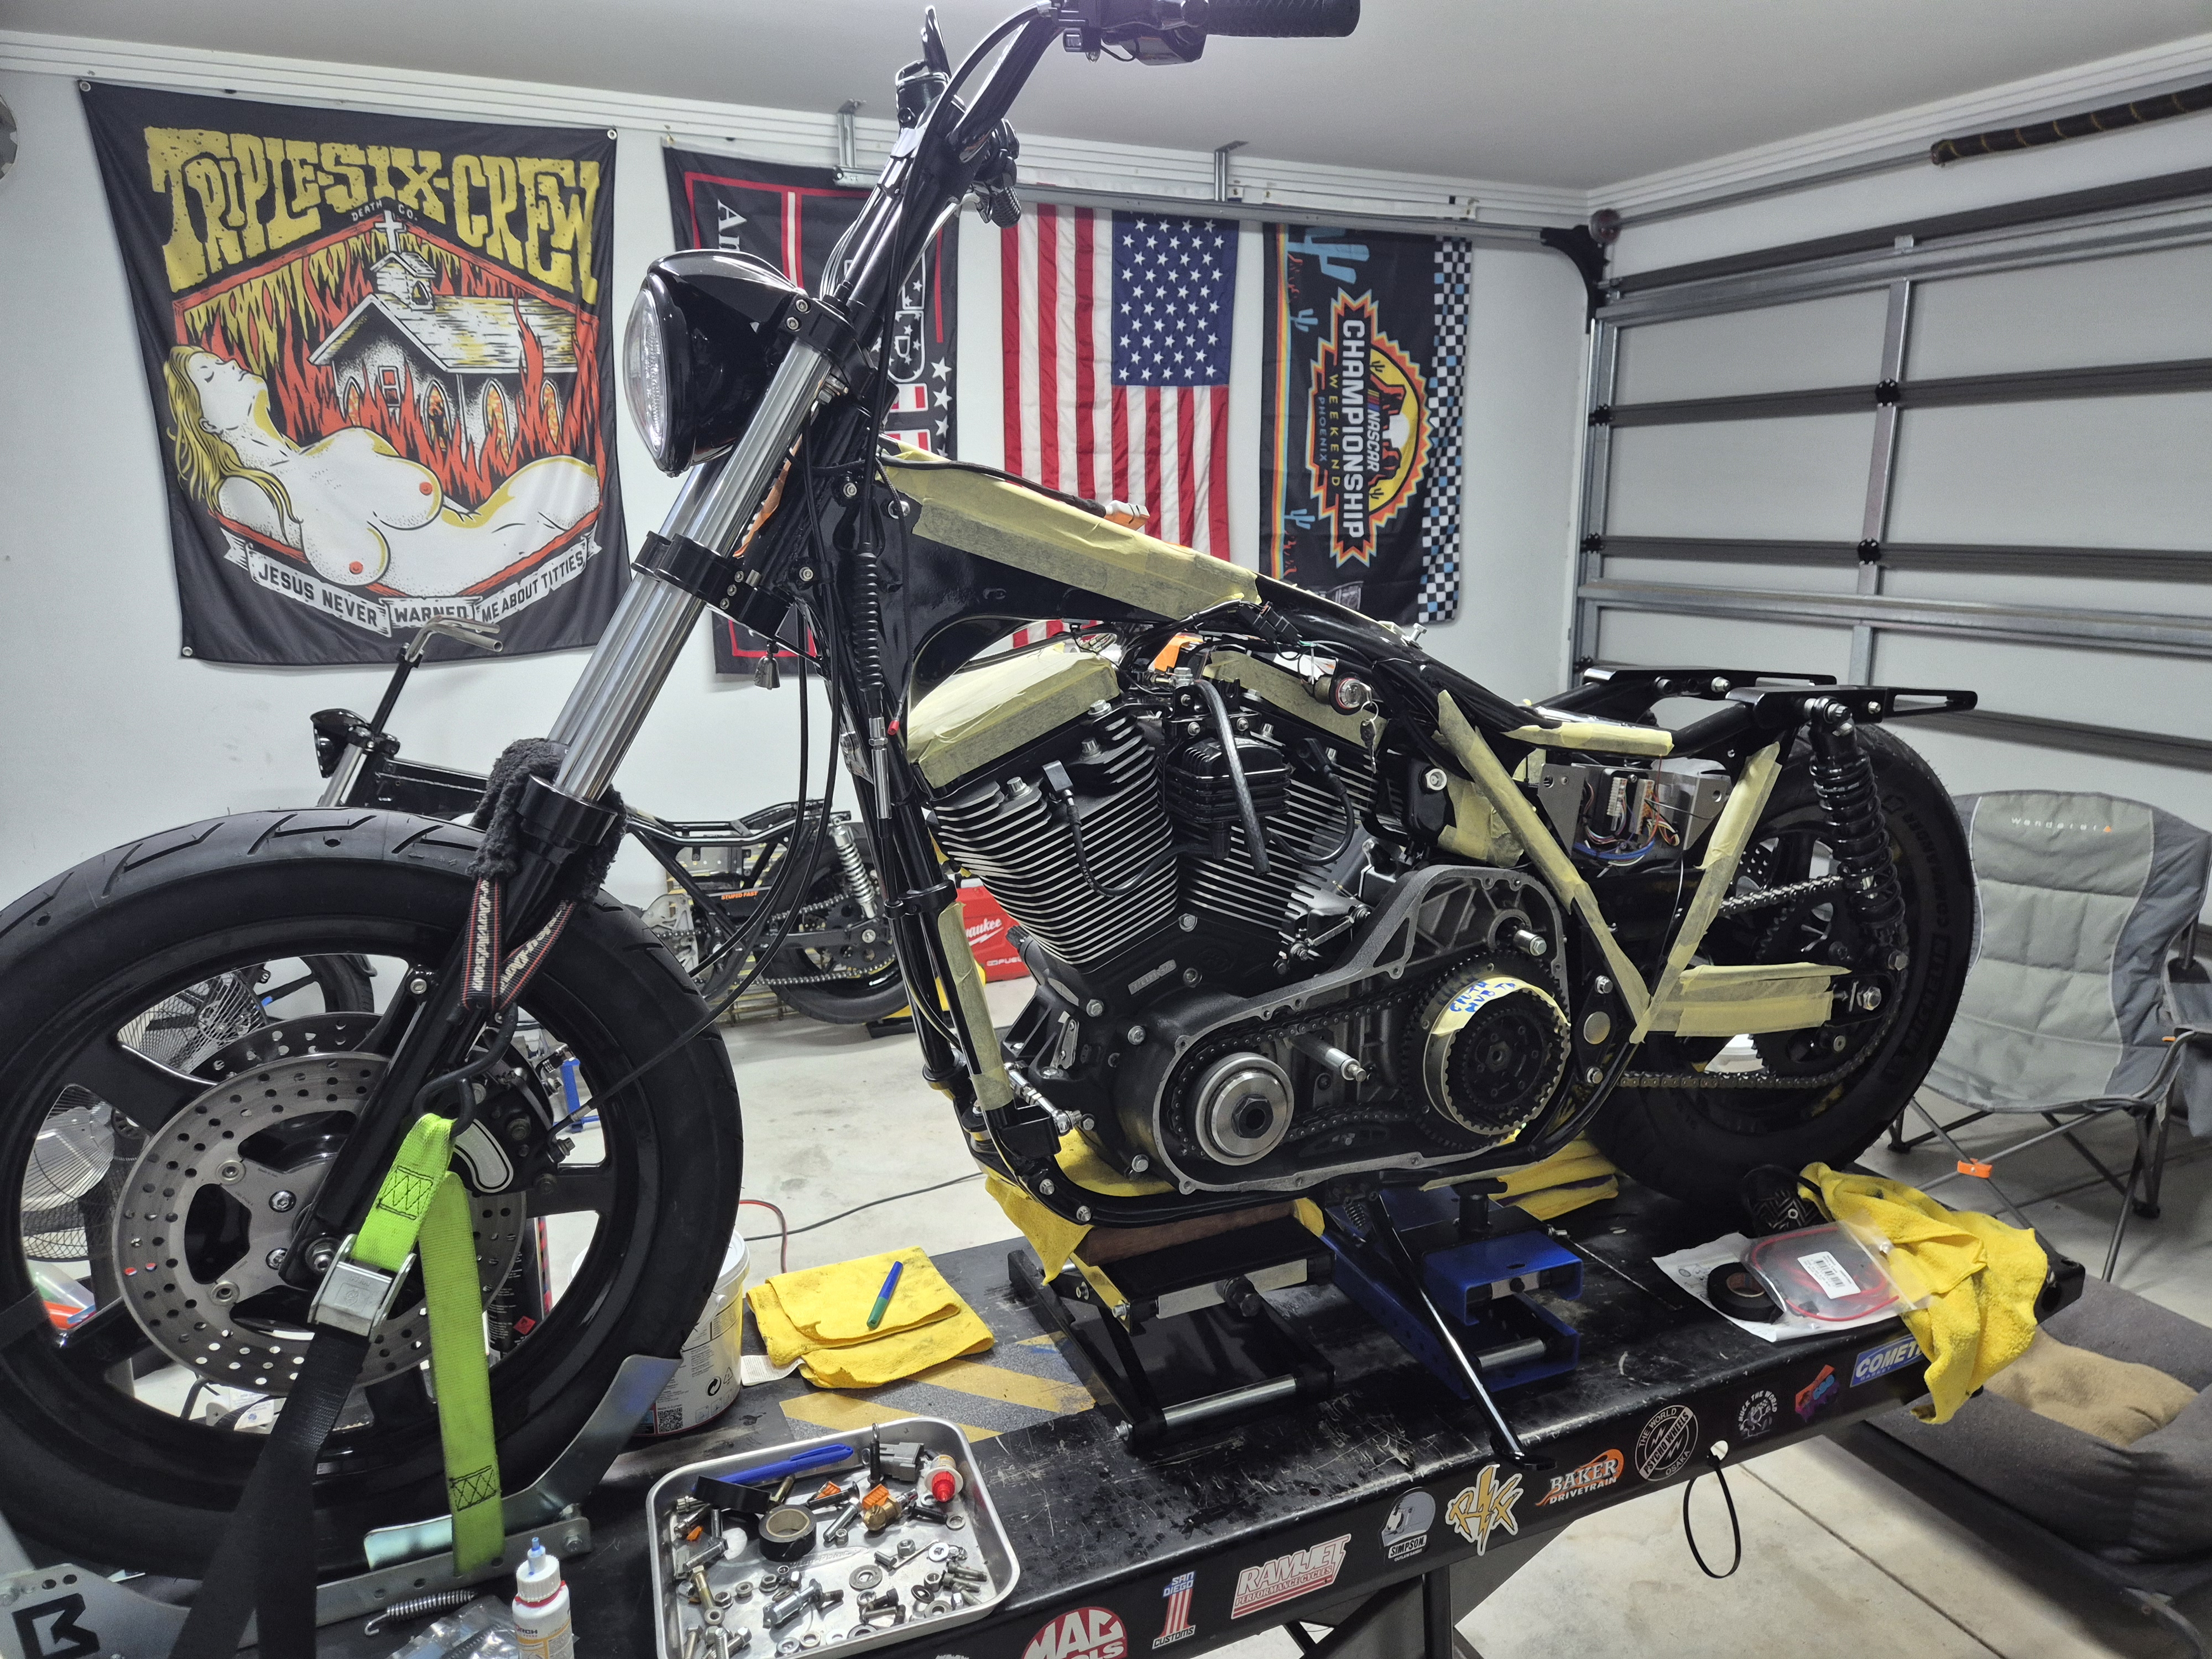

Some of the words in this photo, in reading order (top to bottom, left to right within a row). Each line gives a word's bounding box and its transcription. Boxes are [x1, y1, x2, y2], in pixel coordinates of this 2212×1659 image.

[352, 201, 383, 221] DEATH
[1318, 397, 1326, 462] PHOENIX
[1330, 373, 1340, 487] WEEKEND
[1342, 319, 1365, 539] CHAMPIONSHIP
[1367, 410, 1381, 473] NASCAR
[258, 564, 315, 601] JESUS
[322, 589, 377, 627] NEVER
[482, 608, 499, 625] ME
[502, 585, 539, 612] ABOUT
[541, 551, 584, 590] TITTIES
[1082, 865, 1094, 887] TAYLOR
[966, 917, 1002, 938] aukee
[1856, 1341, 1922, 1378] COMET
[1751, 1390, 1764, 1401] THE
[1765, 1390, 1777, 1412] WORLD
[1638, 1430, 1650, 1448] THE
[1648, 1408, 1677, 1428] WORLD
[1643, 1442, 1667, 1475] PSYCHO
[1665, 1411, 1689, 1444] WHEELS
[1550, 1459, 1618, 1493] BAKER
[1666, 1451, 1691, 1475] OSAKA
[1550, 1477, 1617, 1504] DRIVETRAIN
[1390, 1536, 1424, 1557] SIMPSON
[1172, 1572, 1194, 1585] SAN
[1237, 1536, 1349, 1597] RAMJET
[1163, 1580, 1194, 1597] DIEGO
[1235, 1578, 1300, 1606] PERFORMANCE
[1300, 1566, 1332, 1583] CYCLES
[1024, 1609, 1124, 1659] MAC
[1153, 1626, 1196, 1647] CUSTOMS
